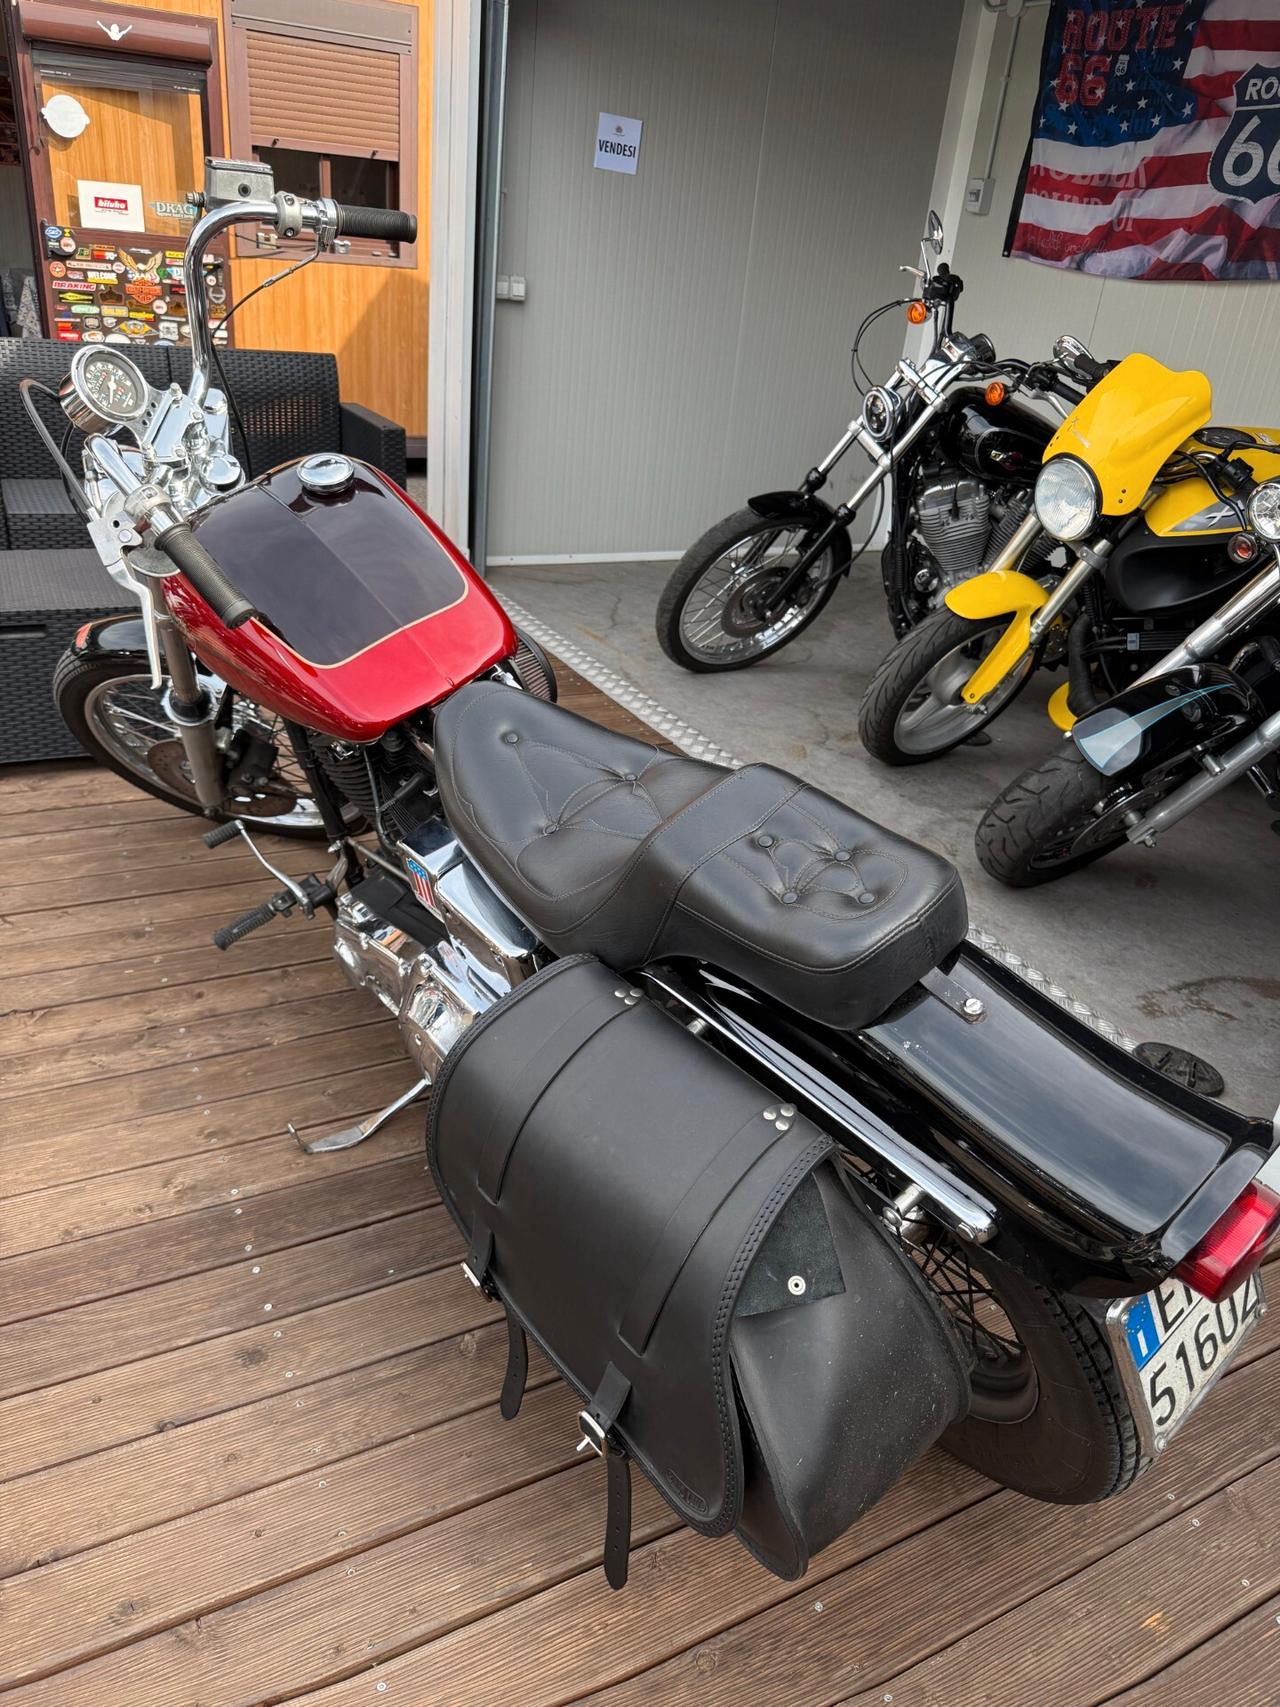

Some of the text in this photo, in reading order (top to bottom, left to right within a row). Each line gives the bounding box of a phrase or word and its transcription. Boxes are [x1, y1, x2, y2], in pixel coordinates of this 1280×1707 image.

[1063, 4, 1184, 51] ROUTE
[1055, 53, 1110, 106] 66
[1245, 76, 1280, 100] RO
[599, 139, 636, 158] VENDESI
[156, 201, 194, 215] DRAG
[54, 281, 95, 290] BRAKING
